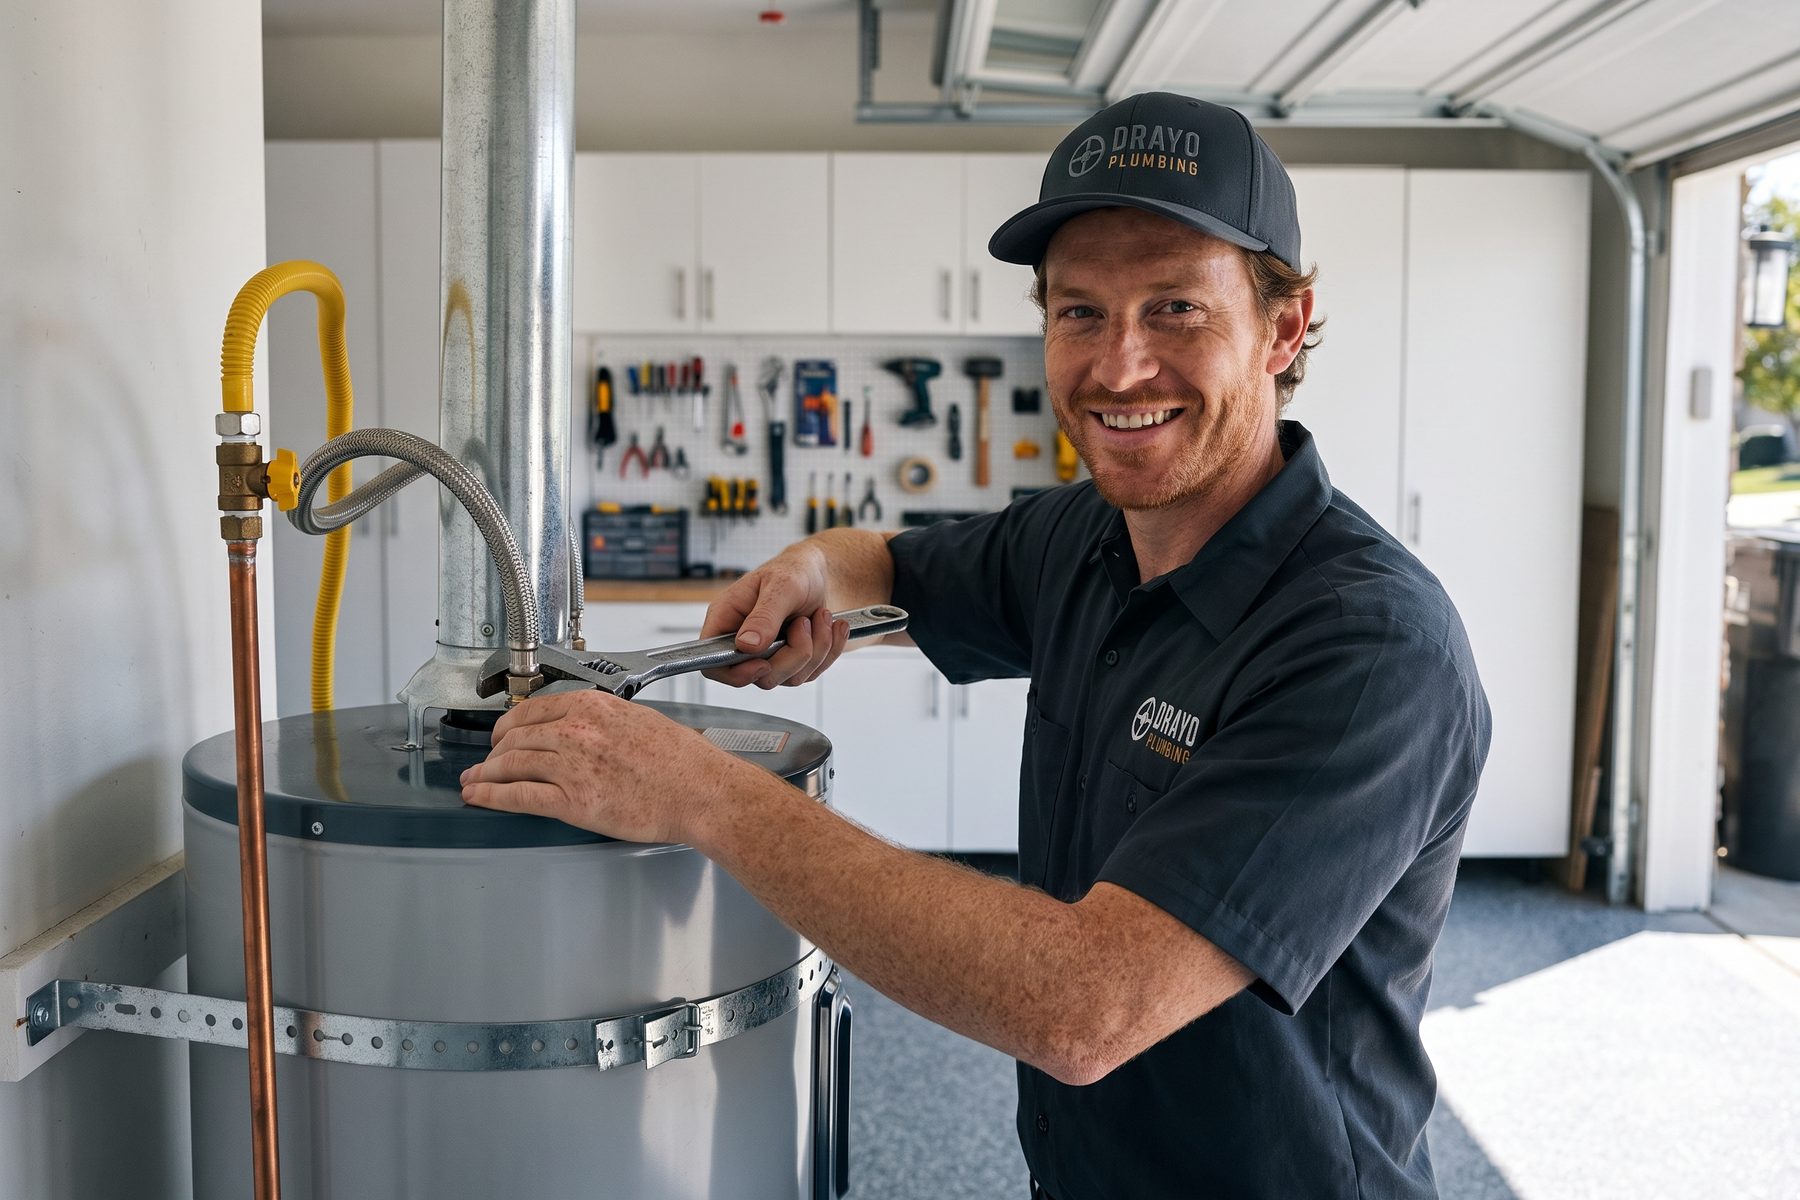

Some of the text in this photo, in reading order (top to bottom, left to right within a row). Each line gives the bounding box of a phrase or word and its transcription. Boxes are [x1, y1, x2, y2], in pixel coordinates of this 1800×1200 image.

[1112, 124, 1200, 158] DRAYO
[1108, 153, 1198, 176] PLUMBING
[1152, 701, 1200, 747] DRAYO
